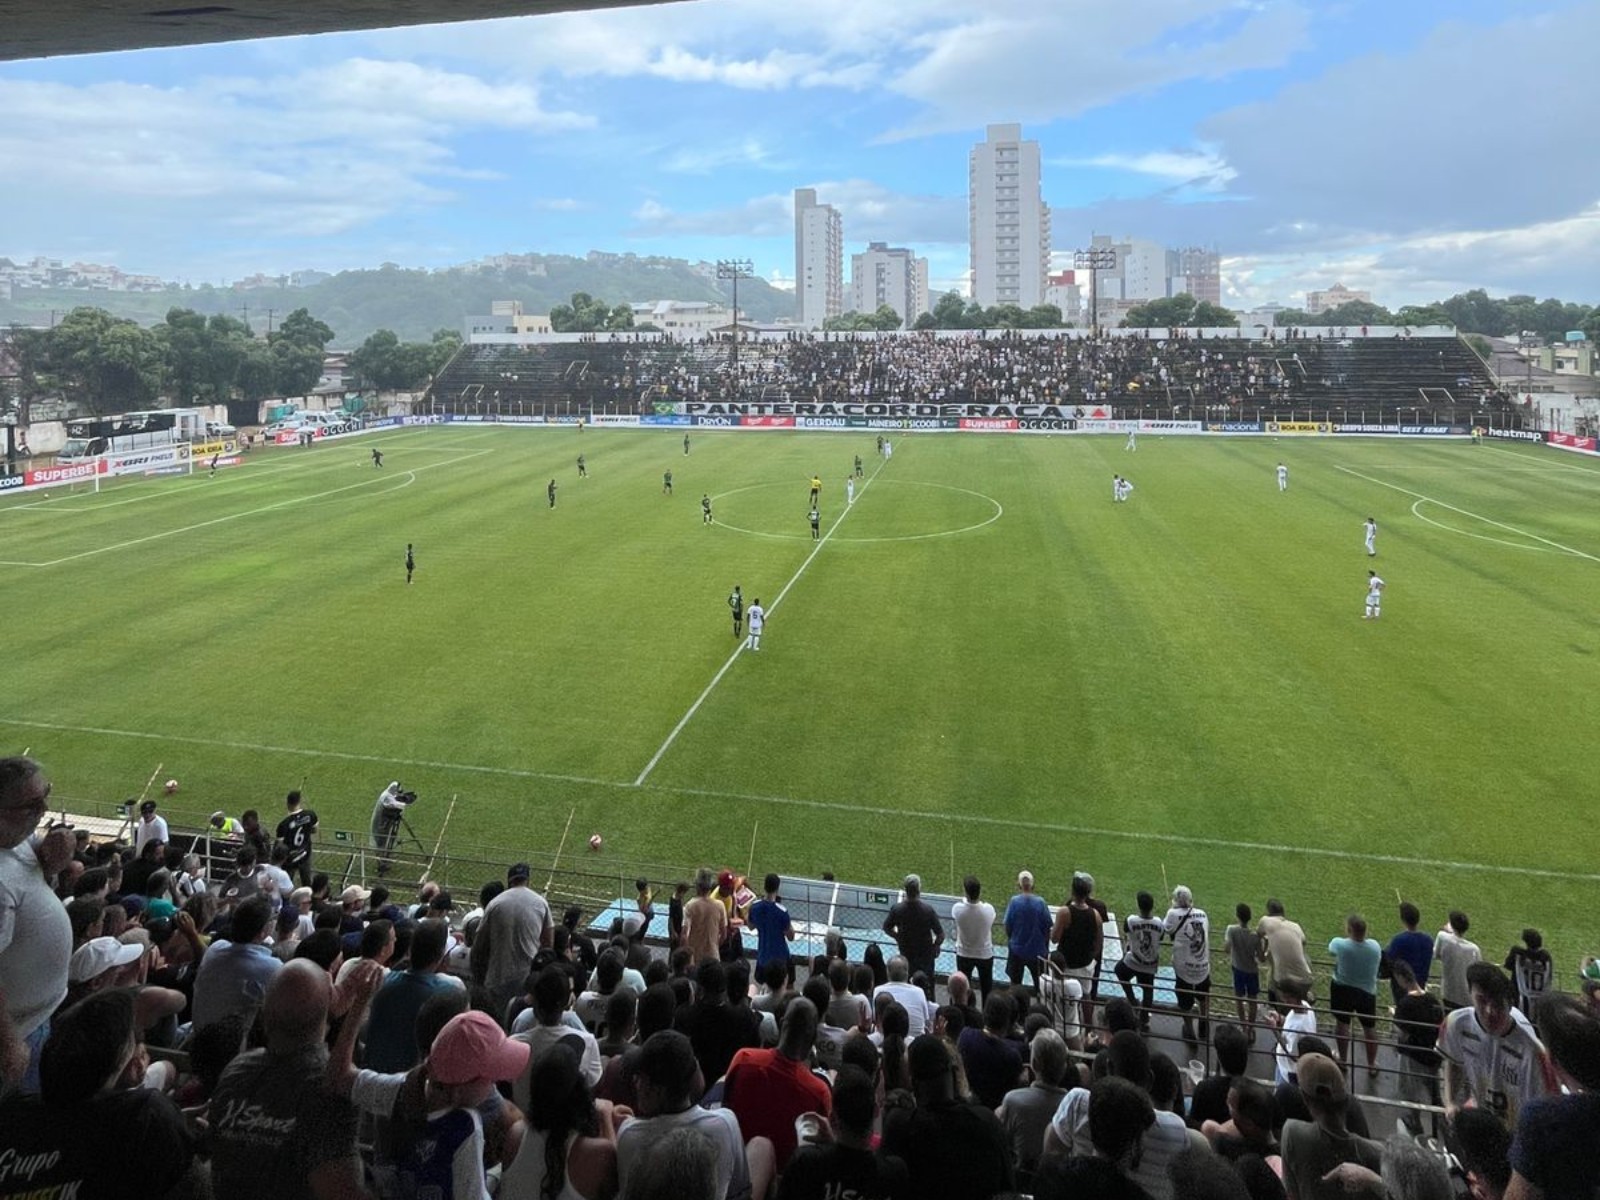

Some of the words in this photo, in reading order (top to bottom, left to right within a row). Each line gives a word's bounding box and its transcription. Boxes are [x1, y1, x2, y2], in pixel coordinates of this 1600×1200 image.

[686, 403, 837, 414] PANTERA
[843, 404, 910, 415] COR
[916, 404, 961, 415] DE
[806, 417, 845, 427] GERDAU
[868, 419, 902, 428] MINEIRO
[965, 420, 1013, 429] SUPERBET
[1018, 420, 1076, 430] OGOCHI
[1208, 422, 1260, 431] betnacional
[322, 420, 361, 436] OGOCHI
[1489, 422, 1542, 442] heatmap
[32, 464, 98, 481] SUPERBE
[293, 826, 305, 847] 6
